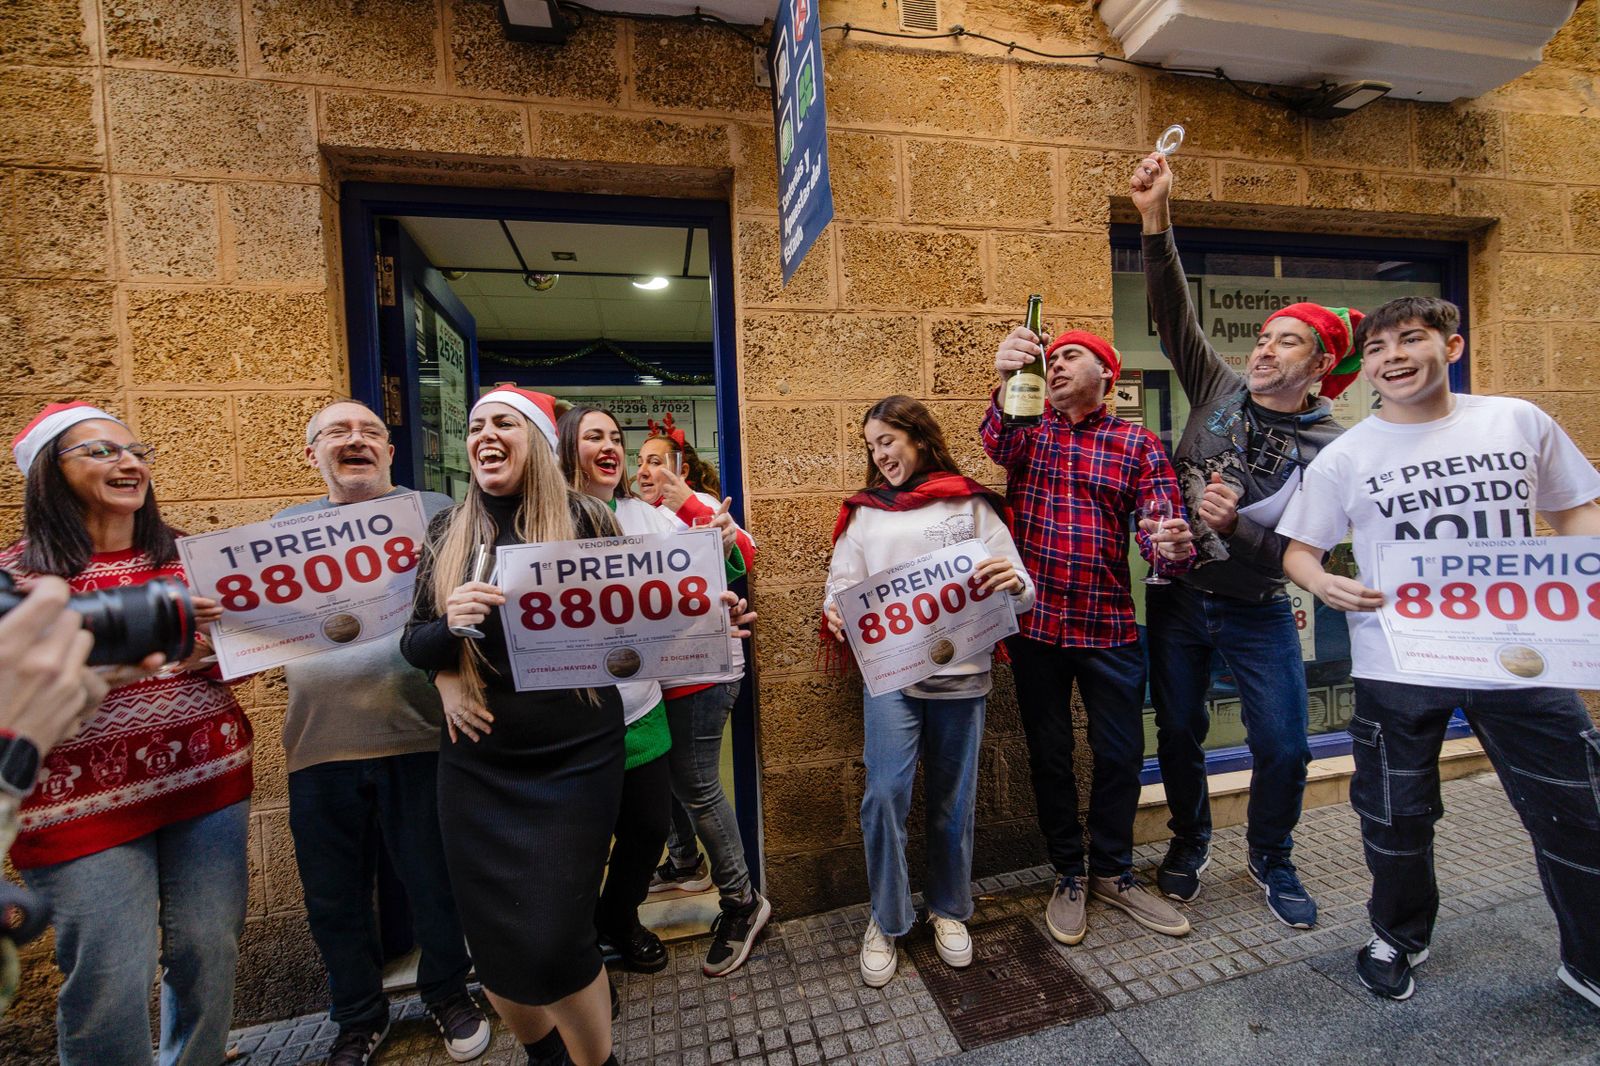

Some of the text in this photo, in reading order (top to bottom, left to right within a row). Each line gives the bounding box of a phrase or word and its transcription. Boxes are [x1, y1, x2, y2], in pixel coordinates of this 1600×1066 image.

[782, 147, 809, 213] Loterías y
[784, 152, 820, 238] Apuestas del
[784, 225, 804, 266] Estado
[1210, 289, 1291, 310] Loterías
[1212, 318, 1264, 342] Apue
[440, 336, 464, 374] 25296
[608, 404, 647, 413] 25296
[652, 404, 690, 413] 87092
[1401, 450, 1527, 484] PREMIO
[1375, 478, 1530, 518] VENDIDO
[270, 508, 342, 530] VENDIDO AQUÍ
[249, 514, 394, 564] PREMIO
[578, 534, 644, 550] VENDIDO AQUÍ
[1467, 540, 1516, 548] VENDIDO
[216, 536, 419, 612] 88008
[556, 548, 691, 584] PREMIO
[886, 554, 933, 575] VENDIDO AQUÍ
[1442, 552, 1600, 577] PREMIO
[876, 554, 973, 603] PREMIO
[519, 576, 711, 630] 88008
[858, 574, 994, 645] 88008
[280, 632, 316, 646] NAVIDAD
[527, 664, 556, 674] LOTERÍA
[564, 663, 597, 671] NAVIDAD
[670, 652, 709, 661] DICIEMBRE
[901, 660, 926, 673] NAVIDAD
[1406, 651, 1440, 660] LOTERÍA
[1447, 655, 1488, 663] NAVIDAD
